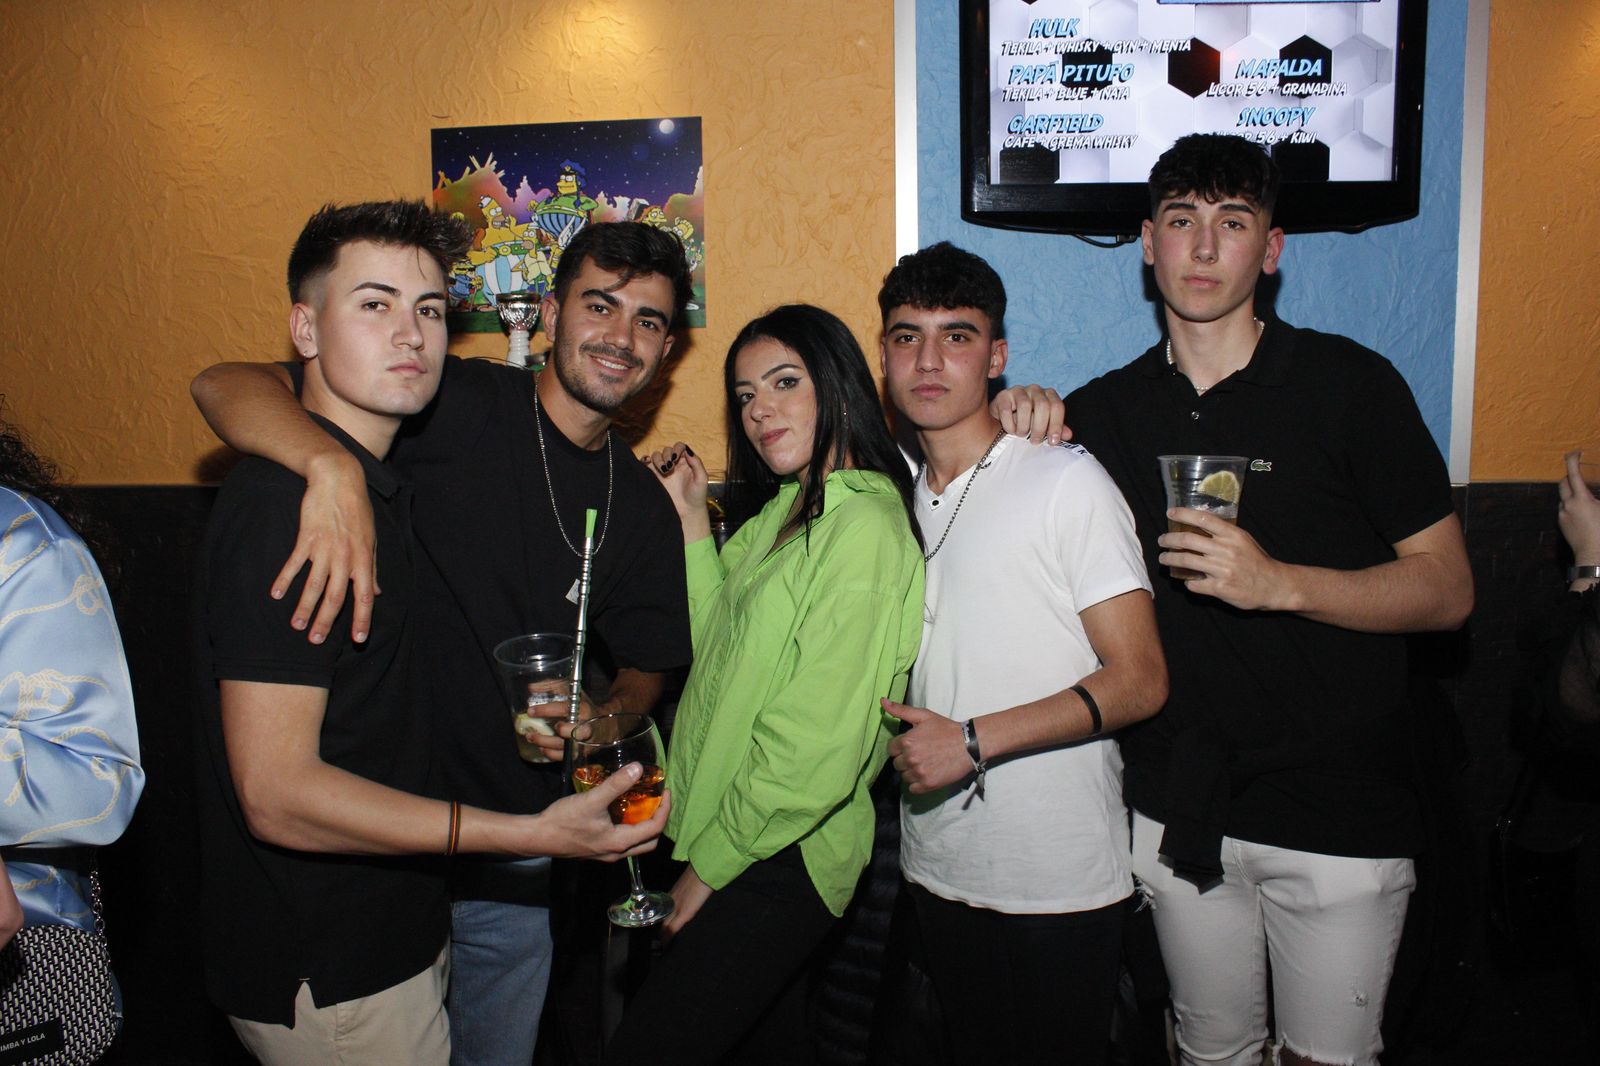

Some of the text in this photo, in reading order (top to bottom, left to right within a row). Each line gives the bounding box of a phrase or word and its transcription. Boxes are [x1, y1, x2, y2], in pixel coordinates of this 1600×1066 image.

[1028, 17, 1080, 39] HULK
[1001, 40, 1043, 56] TEKILA
[1054, 39, 1100, 55] WHISKY
[1149, 39, 1191, 54] MENTA
[1060, 63, 1135, 83] PITUFO
[1235, 58, 1323, 79] MAFALDA
[1002, 87, 1044, 102] TEKILA
[1055, 86, 1088, 102] BLUE
[1099, 86, 1130, 101] NATA
[1206, 82, 1243, 97] LICOR
[1245, 81, 1267, 97] 56
[1280, 82, 1348, 97] GRANADINA
[1007, 113, 1105, 135] GARFIELD
[1236, 106, 1316, 127] SNOOPY
[1091, 135, 1138, 150] WHISKY
[1255, 130, 1276, 145] 56
[1290, 130, 1318, 144] KIWI
[20, 1038, 26, 1046] Y
[27, 1032, 46, 1044] LOLA
